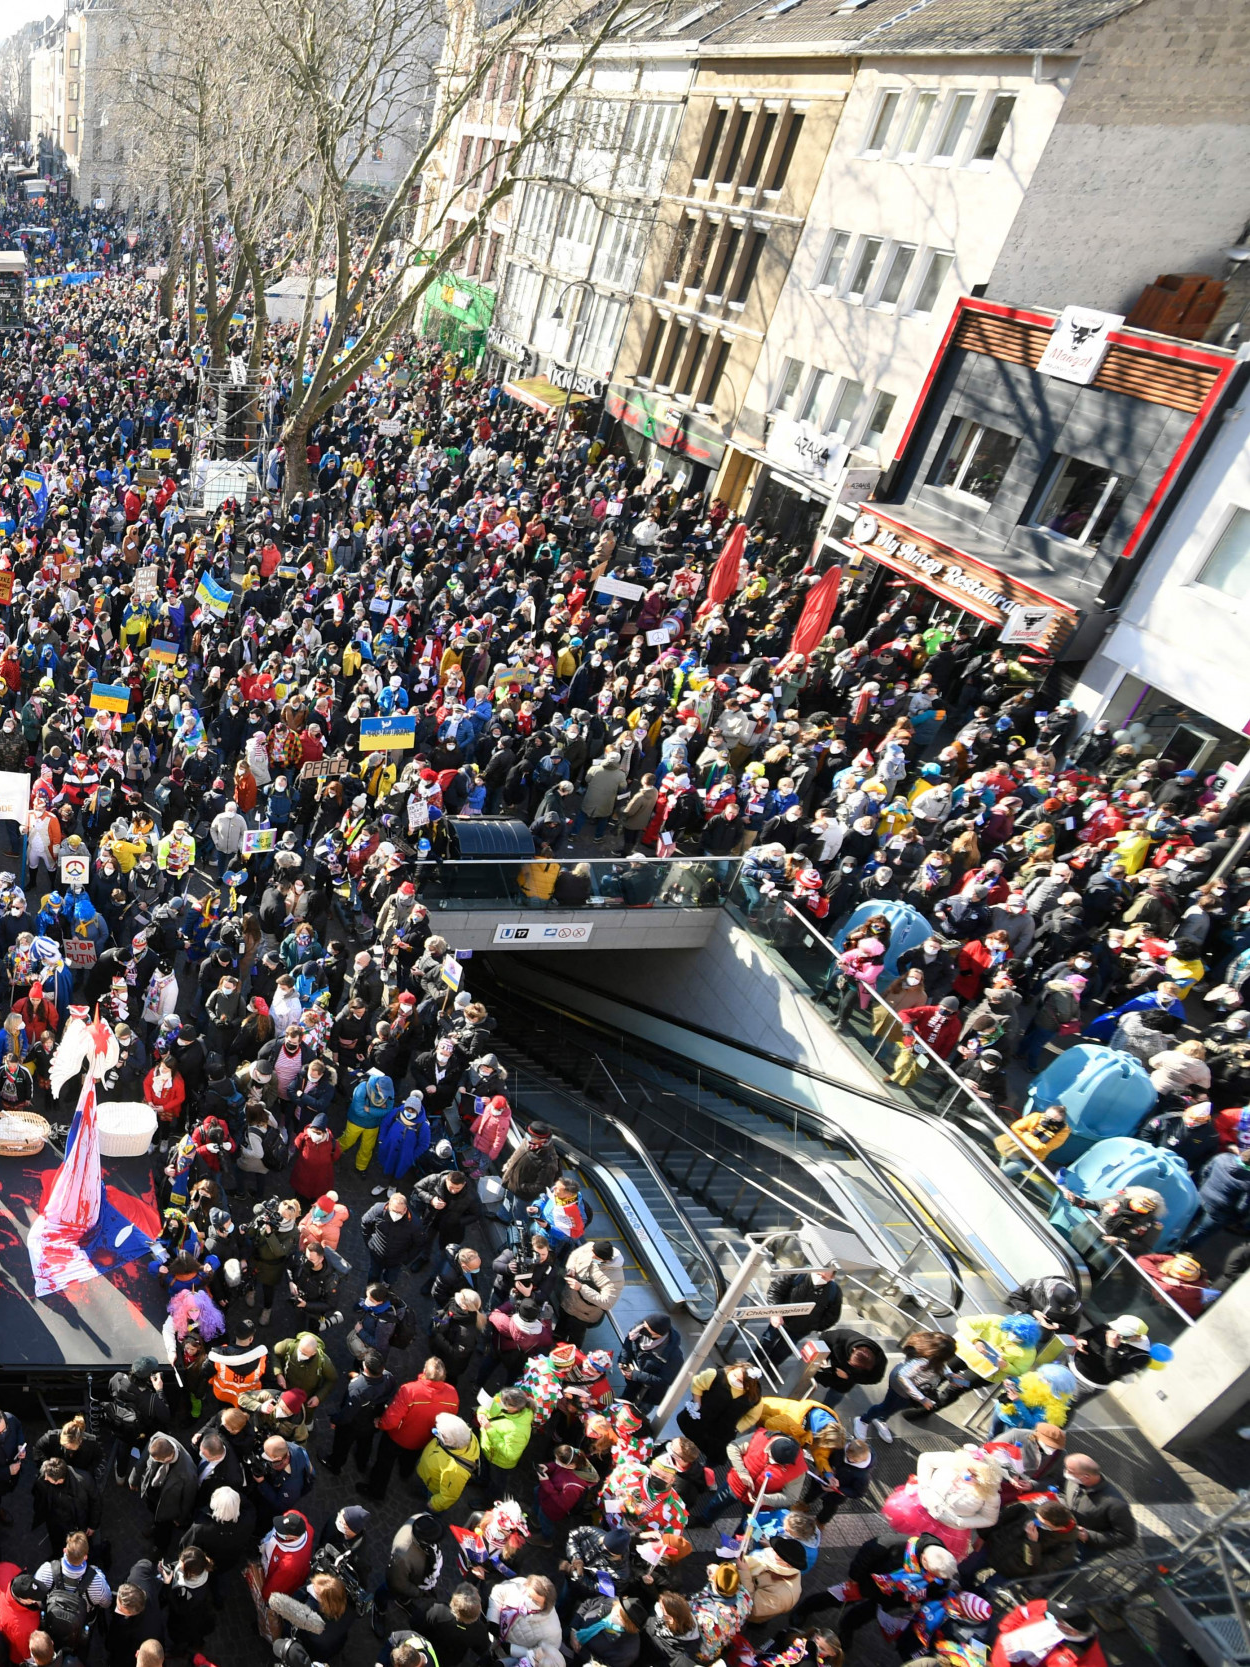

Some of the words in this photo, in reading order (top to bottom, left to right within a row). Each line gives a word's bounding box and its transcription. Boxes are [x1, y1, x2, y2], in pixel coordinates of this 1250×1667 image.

[1048, 348, 1093, 368] Mangal
[551, 369, 599, 396] KIOSK
[138, 570, 156, 578] Putin
[873, 529, 900, 556] My
[898, 543, 943, 576] Antep
[943, 565, 1020, 614] Restaura
[304, 760, 347, 777] PEACE
[66, 942, 93, 951] STOP
[66, 952, 97, 965] PUTIN
[745, 1304, 810, 1319] Chlodwigplatz
